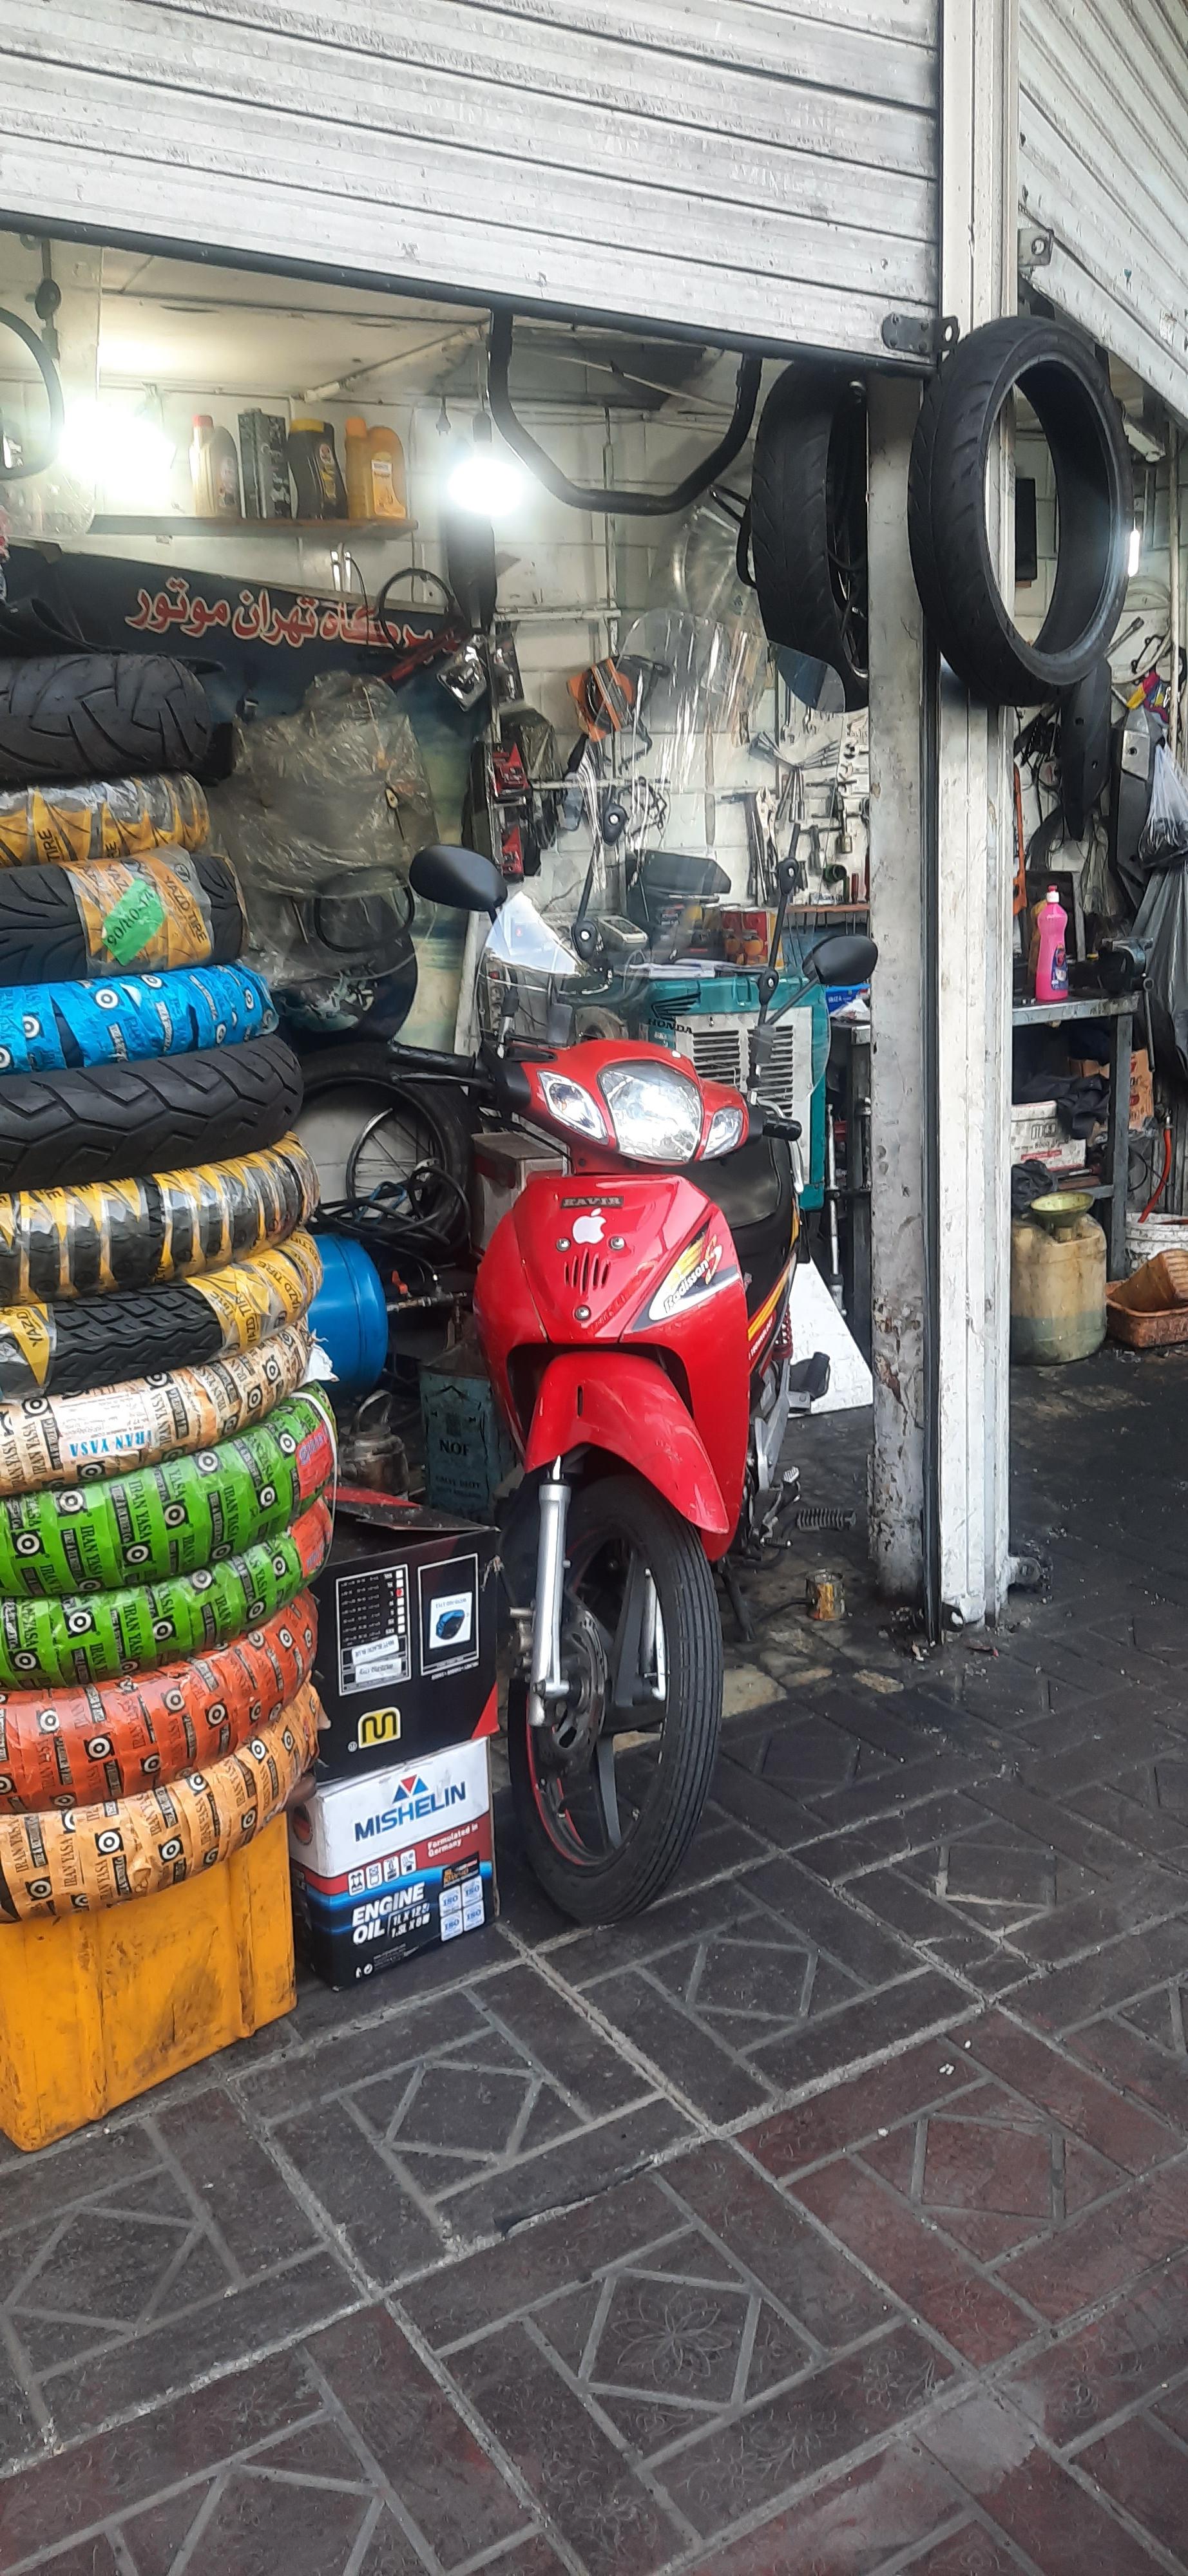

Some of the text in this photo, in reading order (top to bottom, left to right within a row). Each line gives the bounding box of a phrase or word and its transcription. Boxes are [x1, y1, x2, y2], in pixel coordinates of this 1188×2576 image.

[125, 577, 231, 638] موتور
[232, 588, 318, 648] تهران
[164, 876, 208, 943] YAZD TIRE
[648, 1018, 693, 1034] HONDA
[664, 1258, 709, 1314] Radisson
[17, 1311, 43, 1347] YAZD
[68, 1430, 152, 1457] IRAN YASA
[129, 1480, 153, 1540] IRAN YASA
[80, 1524, 97, 1553] IRAN
[123, 1604, 141, 1631] IRAN
[354, 1781, 466, 1842] MISHELIN
[428, 1839, 462, 1859] Germany
[352, 1881, 425, 1928] ENGINE
[352, 1918, 385, 1945] OIL
